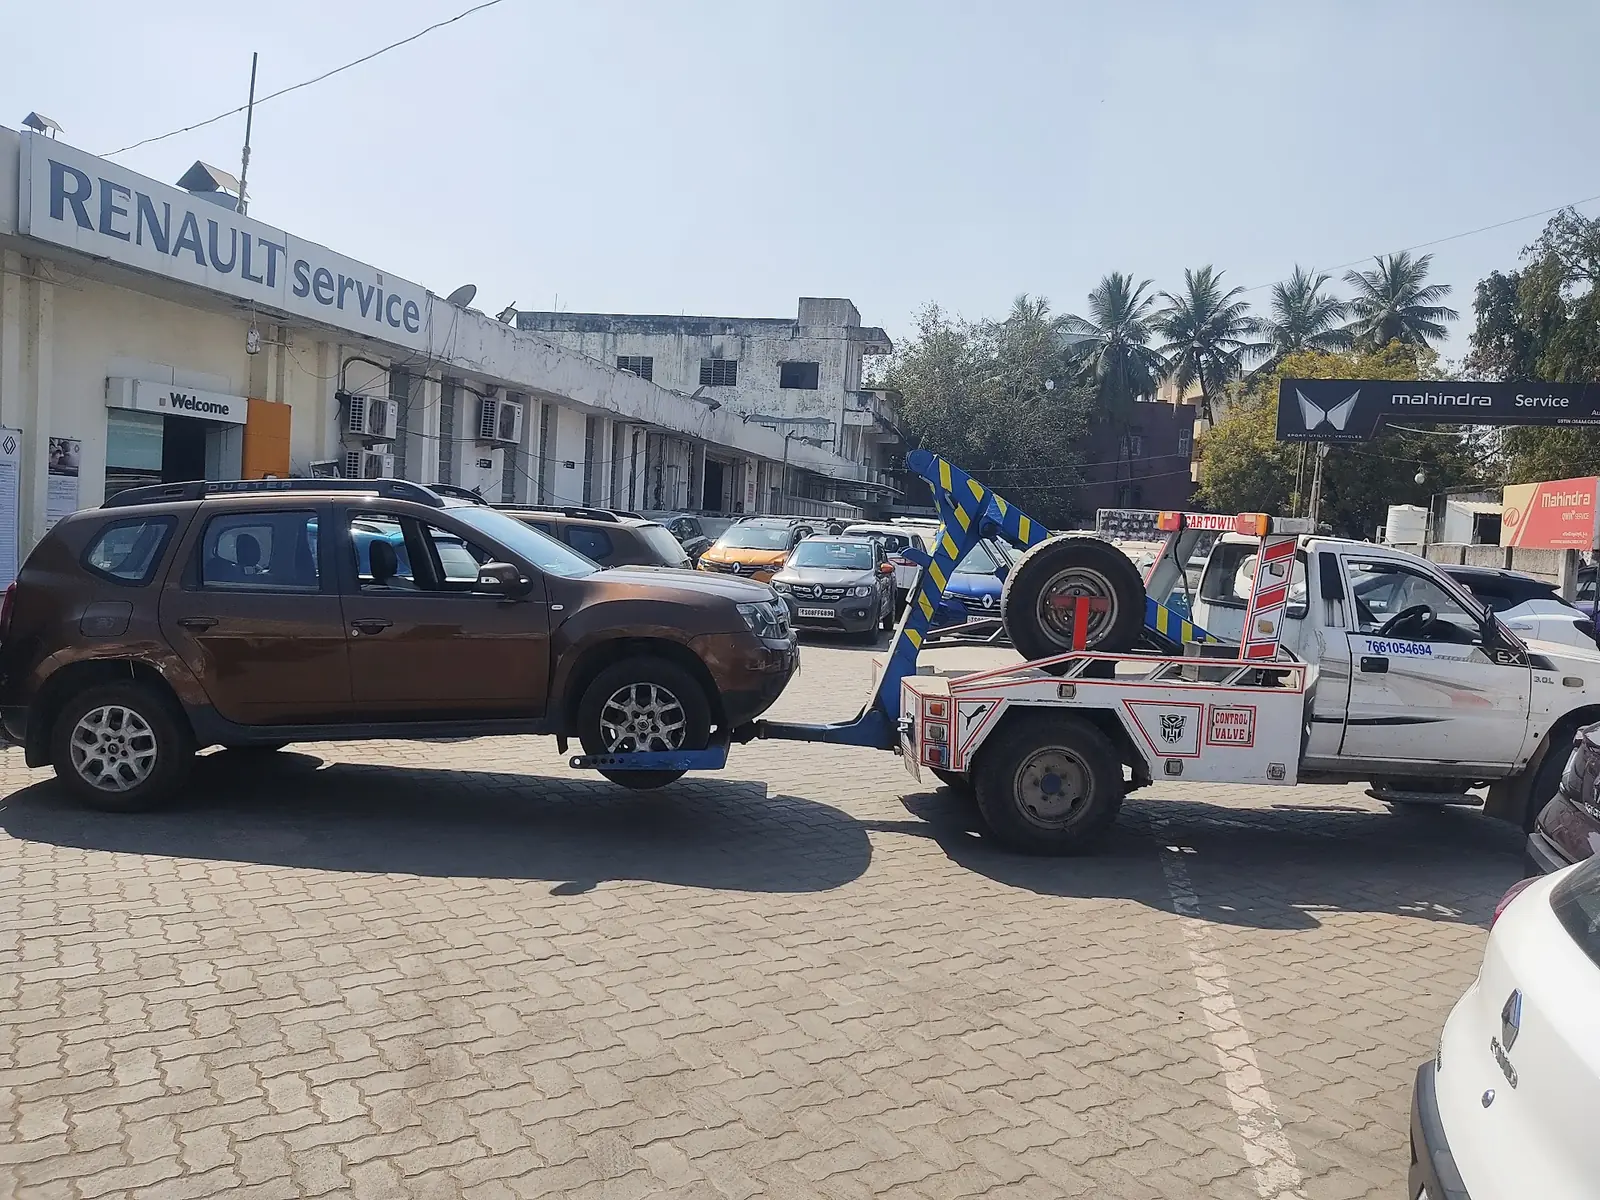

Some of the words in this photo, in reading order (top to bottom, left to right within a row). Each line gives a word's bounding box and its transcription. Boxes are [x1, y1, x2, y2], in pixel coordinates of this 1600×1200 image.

[48, 159, 285, 288] RENAULT
[292, 259, 420, 333] service
[169, 392, 229, 415] Welcome
[1391, 392, 1492, 406] mahindra
[1515, 394, 1569, 407] Service
[208, 482, 292, 491] DUSTER
[1541, 491, 1590, 508] Mahindra
[1365, 640, 1432, 656] 7661054694
[1497, 651, 1521, 664] EX
[1215, 712, 1248, 725] CONTROL
[1215, 728, 1245, 740] VALVE
